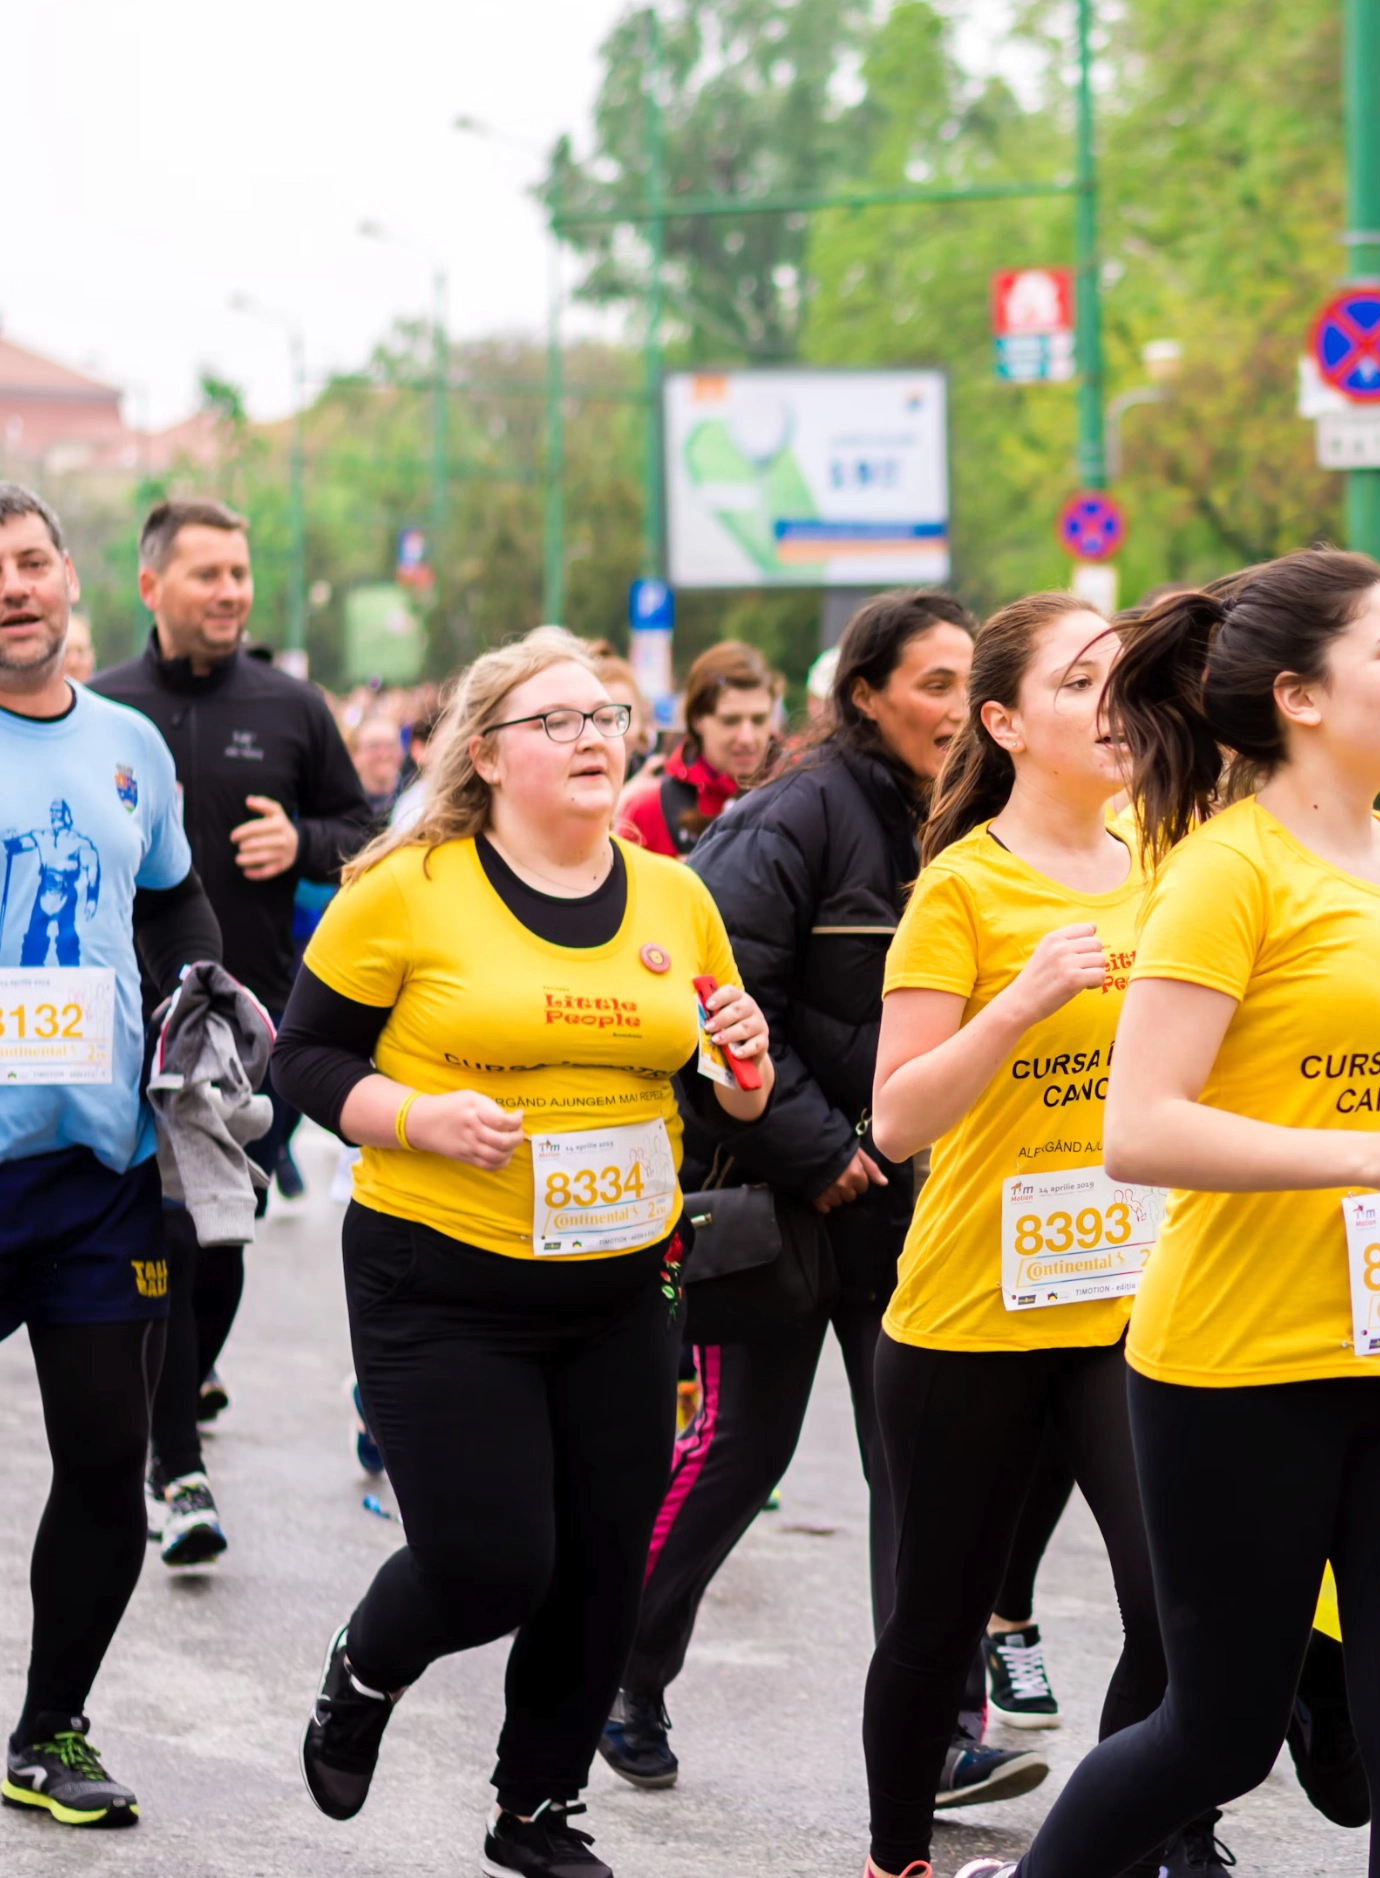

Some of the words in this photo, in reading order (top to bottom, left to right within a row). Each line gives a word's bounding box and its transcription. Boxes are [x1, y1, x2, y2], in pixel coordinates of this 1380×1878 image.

[545, 993, 638, 1012] Little
[0, 1002, 83, 1039] 132
[545, 1009, 642, 1029] People
[1012, 1050, 1100, 1080] CURSA
[549, 1095, 616, 1107] AJUNGEM
[619, 1093, 638, 1103] MAI
[544, 1160, 645, 1209] 8334
[1049, 1182, 1075, 1194] aprilie
[1076, 1181, 1095, 1190] 2019
[1011, 1194, 1034, 1202] Motion
[553, 1207, 630, 1231] Continental
[1014, 1202, 1132, 1256] 8393
[1355, 1219, 1376, 1228] Motion
[1026, 1253, 1113, 1282] Continental
[1075, 1286, 1110, 1297] TIMOTION
